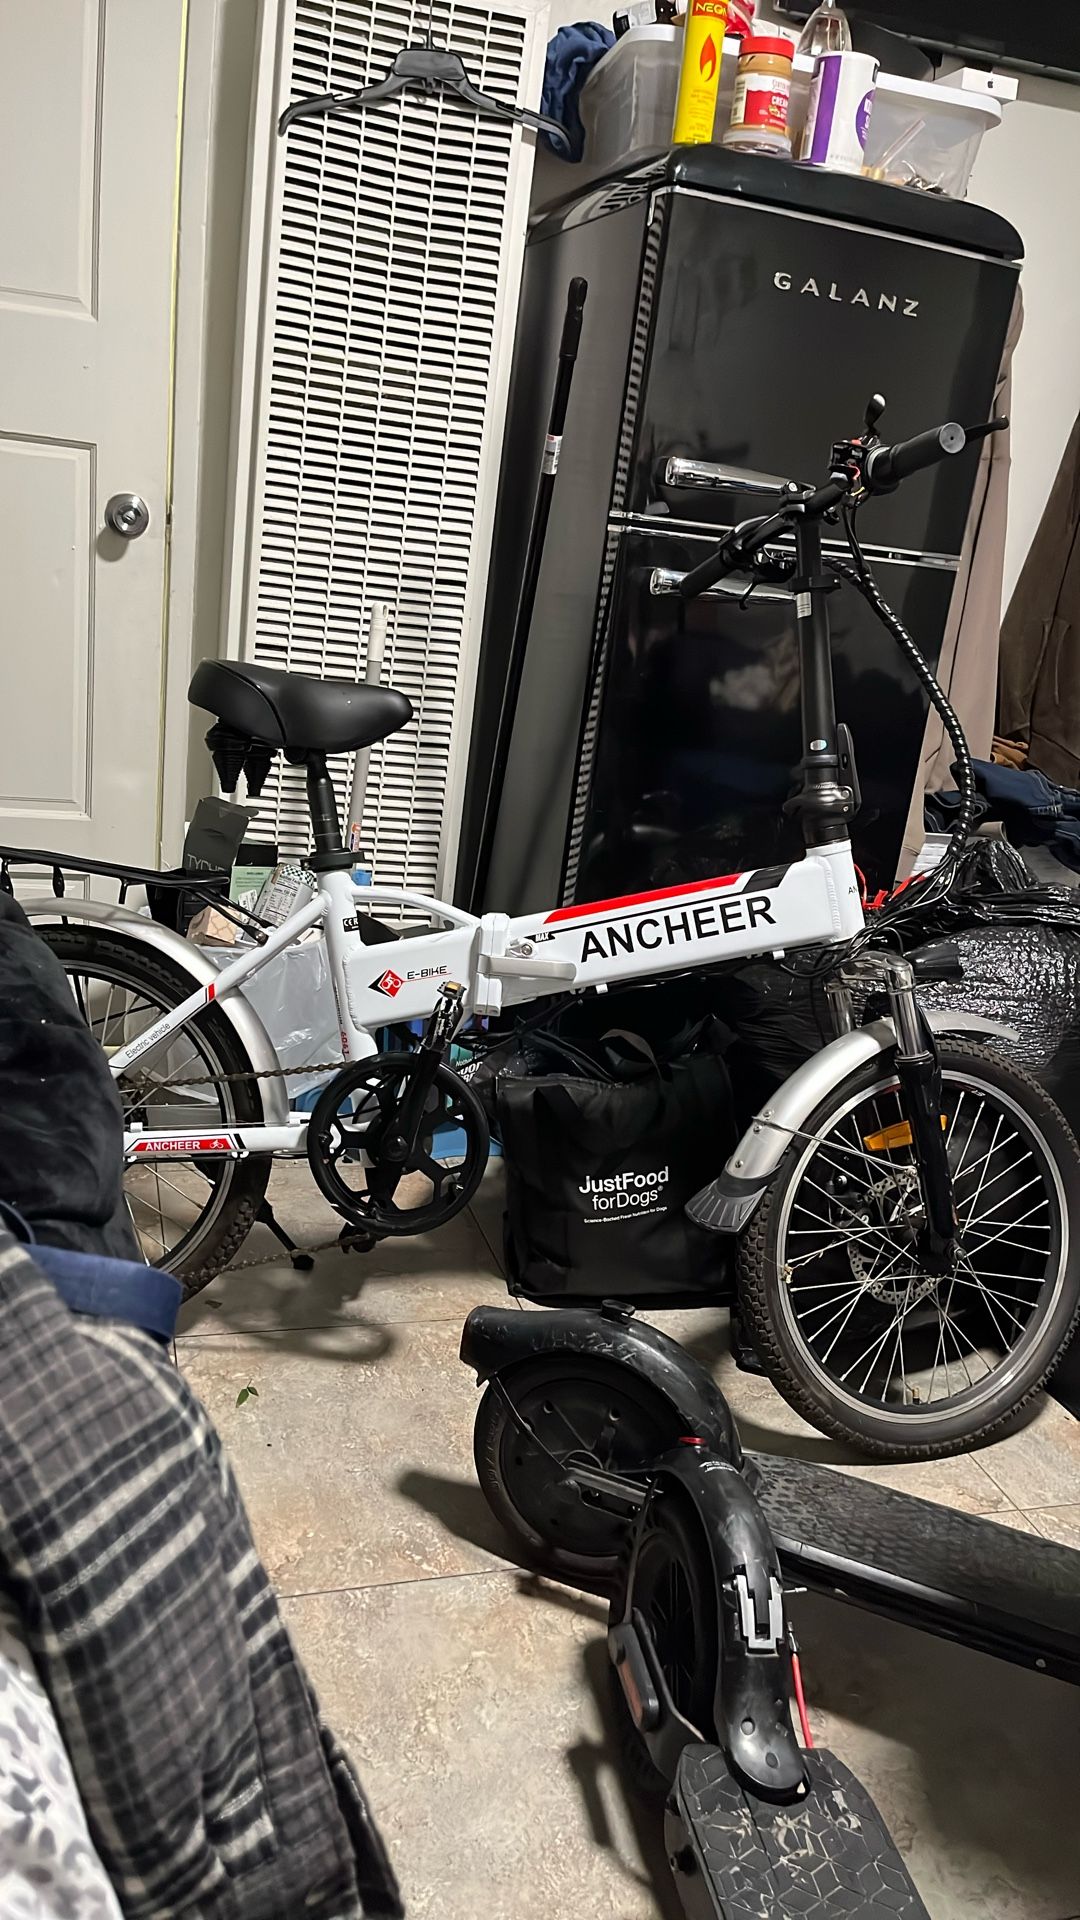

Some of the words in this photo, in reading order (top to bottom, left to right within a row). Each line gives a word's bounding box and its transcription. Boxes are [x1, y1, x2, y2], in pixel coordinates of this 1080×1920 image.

[773, 272, 920, 317] GALANZ
[580, 895, 777, 963] ANCHEER
[406, 965, 448, 980] E-BIKE
[125, 1039, 150, 1059] Electric
[149, 1022, 171, 1041] vehicle
[145, 1140, 201, 1151] ANCHEER
[578, 1165, 669, 1194] JustFood
